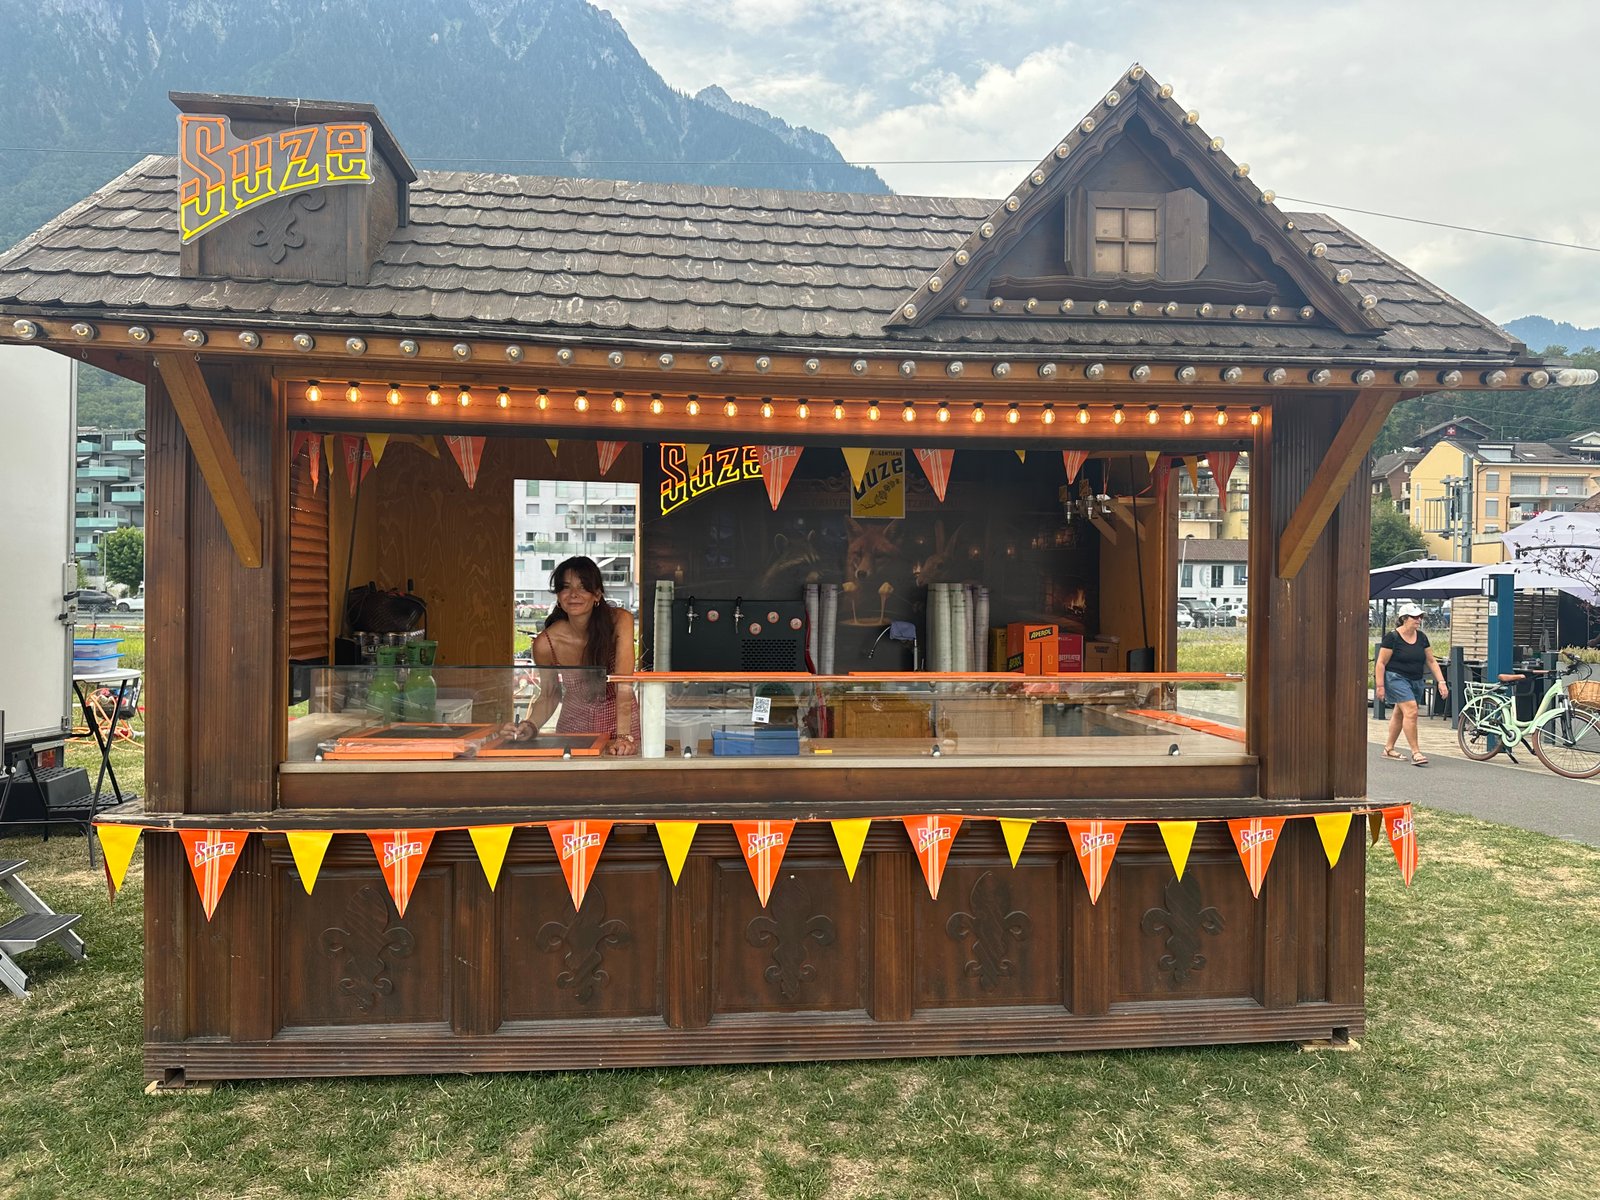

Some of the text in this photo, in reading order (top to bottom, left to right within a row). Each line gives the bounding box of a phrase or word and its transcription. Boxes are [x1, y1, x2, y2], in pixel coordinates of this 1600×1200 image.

[180, 114, 371, 241] Suze
[660, 442, 764, 515] Suze
[1030, 629, 1052, 640] APEROL
[562, 833, 600, 860] Suze
[747, 832, 784, 859] Suze
[918, 827, 952, 853] Suze
[1080, 832, 1115, 857] Suze
[1240, 828, 1274, 853] Suze
[195, 841, 236, 868] Suze
[383, 841, 423, 868] Suze
